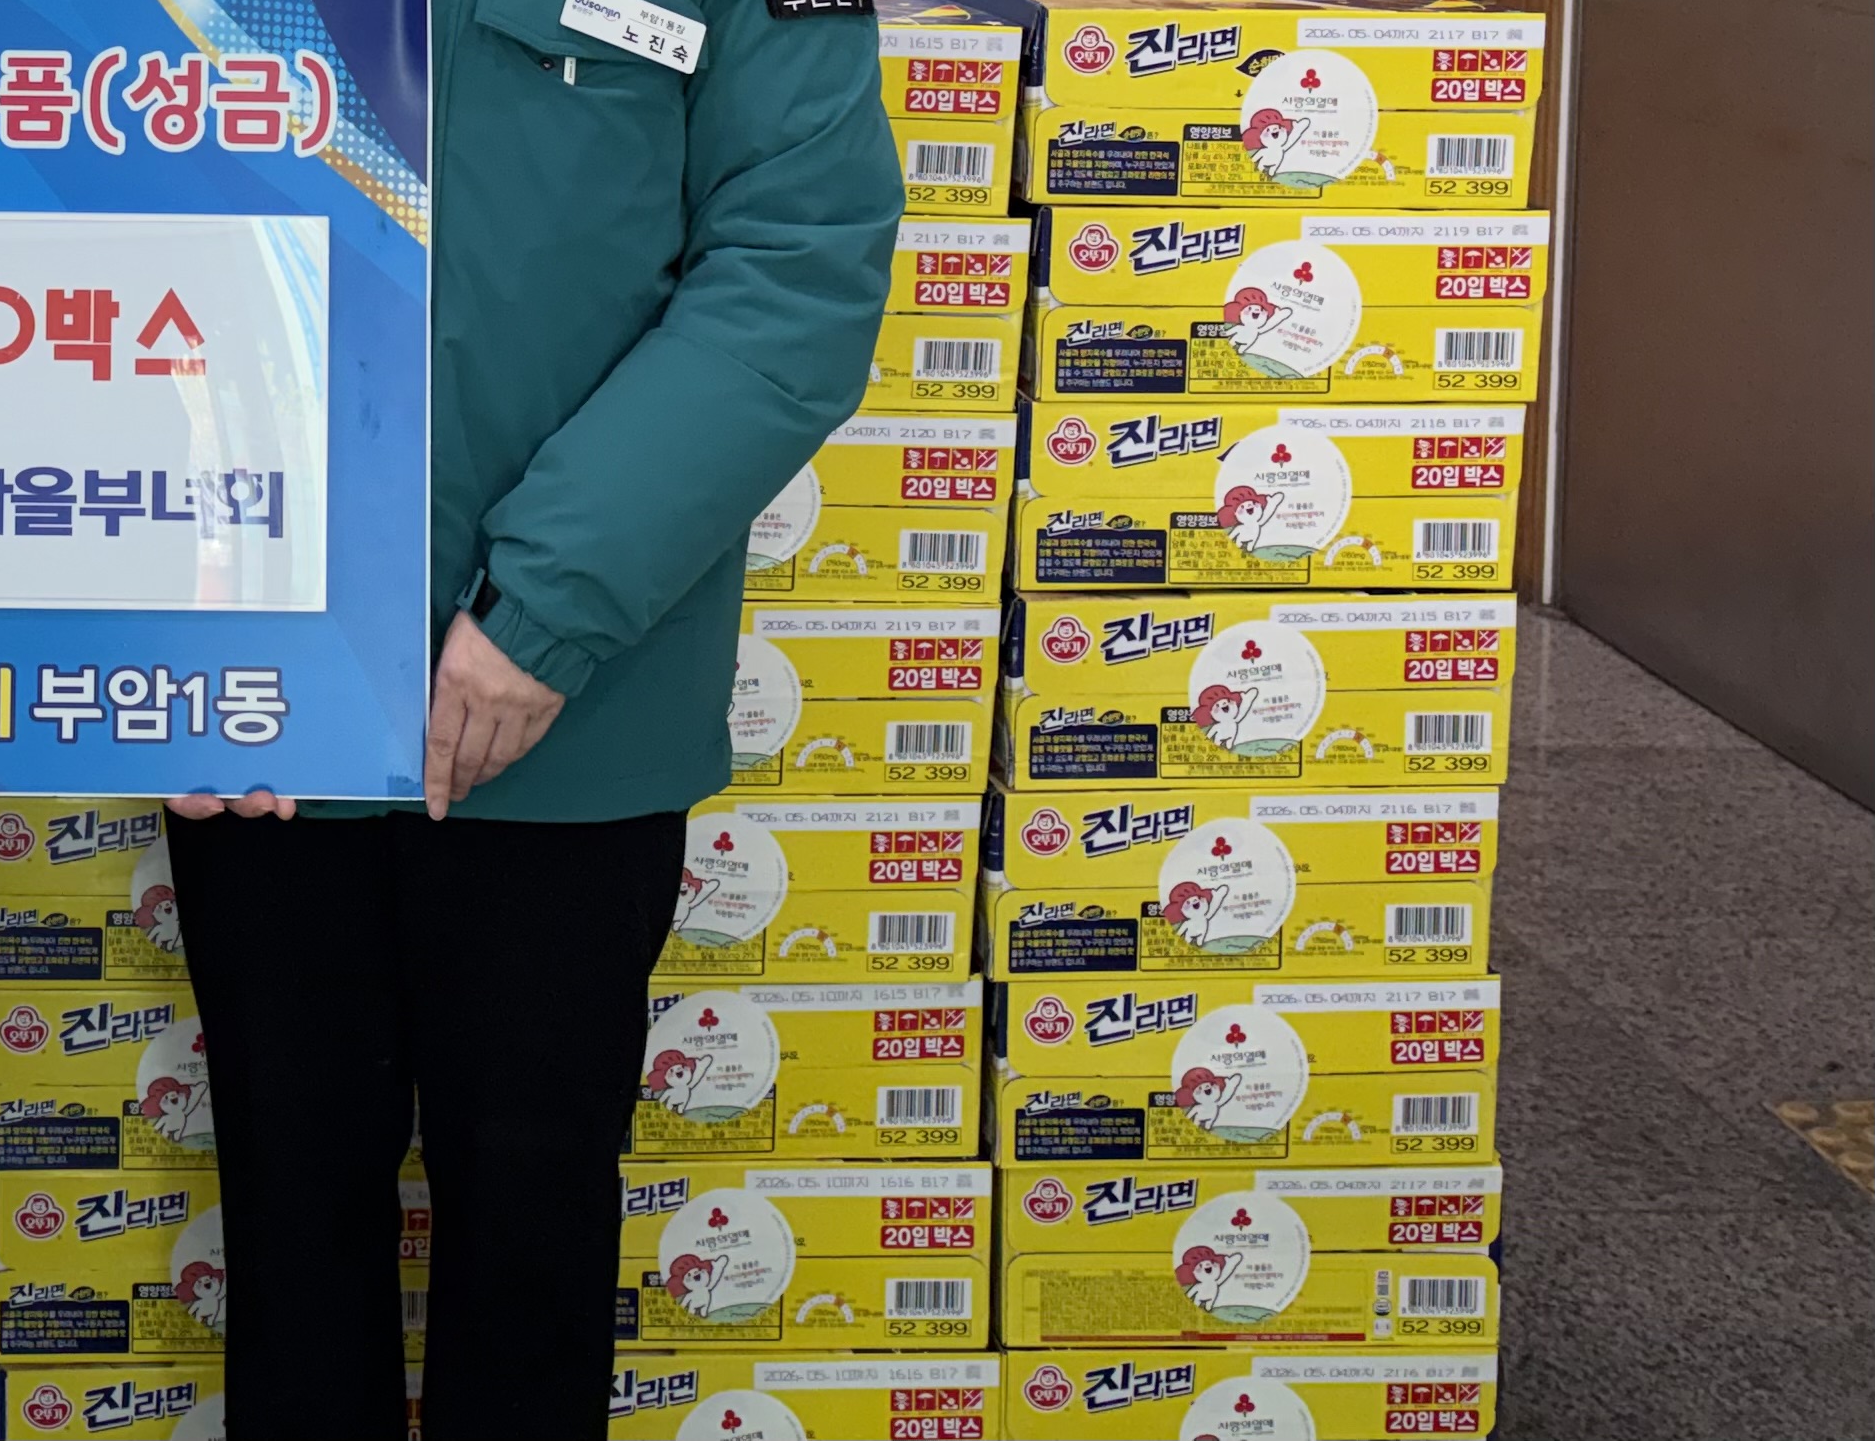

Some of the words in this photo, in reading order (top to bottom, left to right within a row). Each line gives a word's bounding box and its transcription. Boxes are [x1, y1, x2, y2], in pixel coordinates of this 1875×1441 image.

[1428, 29, 1465, 41] 2117
[1471, 29, 1500, 41] B17
[908, 37, 944, 51] 1615
[950, 37, 979, 51] B17
[1124, 23, 1242, 77] 진라면
[1073, 51, 1107, 64] 오뚜기
[1435, 81, 1482, 101] 20입
[1485, 80, 1525, 101] 박스
[909, 90, 955, 110] 20입
[959, 91, 997, 112] 박스
[1189, 125, 1232, 139] 영양정보
[908, 187, 936, 203] 52
[946, 188, 988, 204] 399
[1428, 180, 1457, 196] 52
[1465, 180, 1509, 196] 399
[886, 619, 922, 632] 2119
[928, 619, 956, 632] B17
[893, 668, 938, 689] 20입
[941, 668, 979, 689] 박스
[31, 666, 289, 745] 부암1동
[888, 766, 916, 780] 52
[924, 766, 967, 780] 399
[45, 811, 163, 864] 진라면
[1033, 1386, 1063, 1402] 오뚜기
[1083, 1361, 1194, 1412] 진라면
[1389, 1410, 1436, 1432] 20입
[1438, 1409, 1476, 1432] 박스
